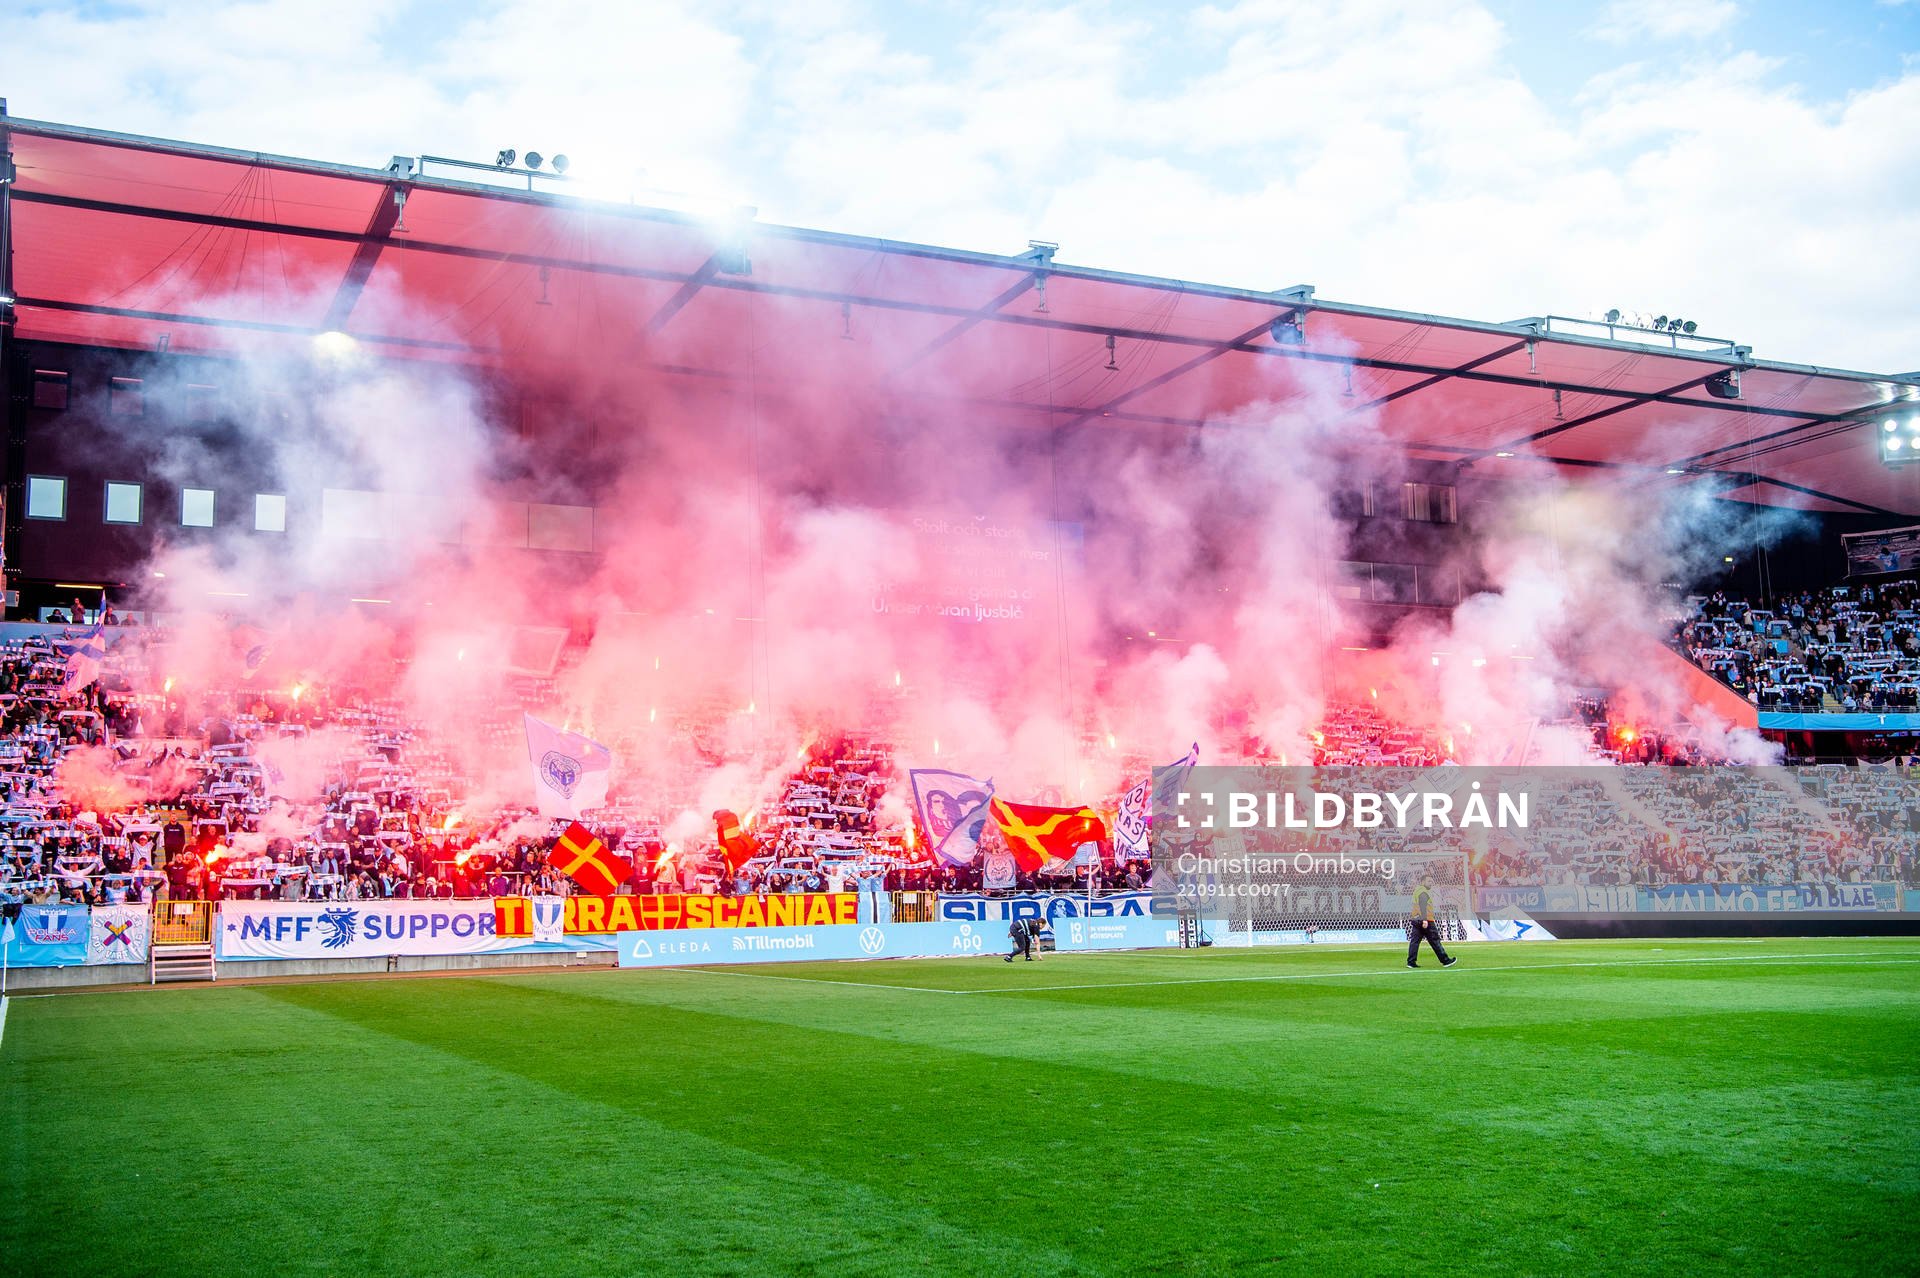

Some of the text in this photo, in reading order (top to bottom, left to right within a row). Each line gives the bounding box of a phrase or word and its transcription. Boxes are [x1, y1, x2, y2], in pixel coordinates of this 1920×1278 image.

[686, 894, 858, 929] SCANIAE
[28, 928, 77, 938] POLSKA
[240, 914, 314, 942] MFF
[1187, 913, 1198, 948] SELECT
[34, 933, 70, 943] FANS
[744, 934, 815, 951] Tillmobil
[952, 934, 983, 952] ApQ
[659, 941, 712, 954] ELEDA
